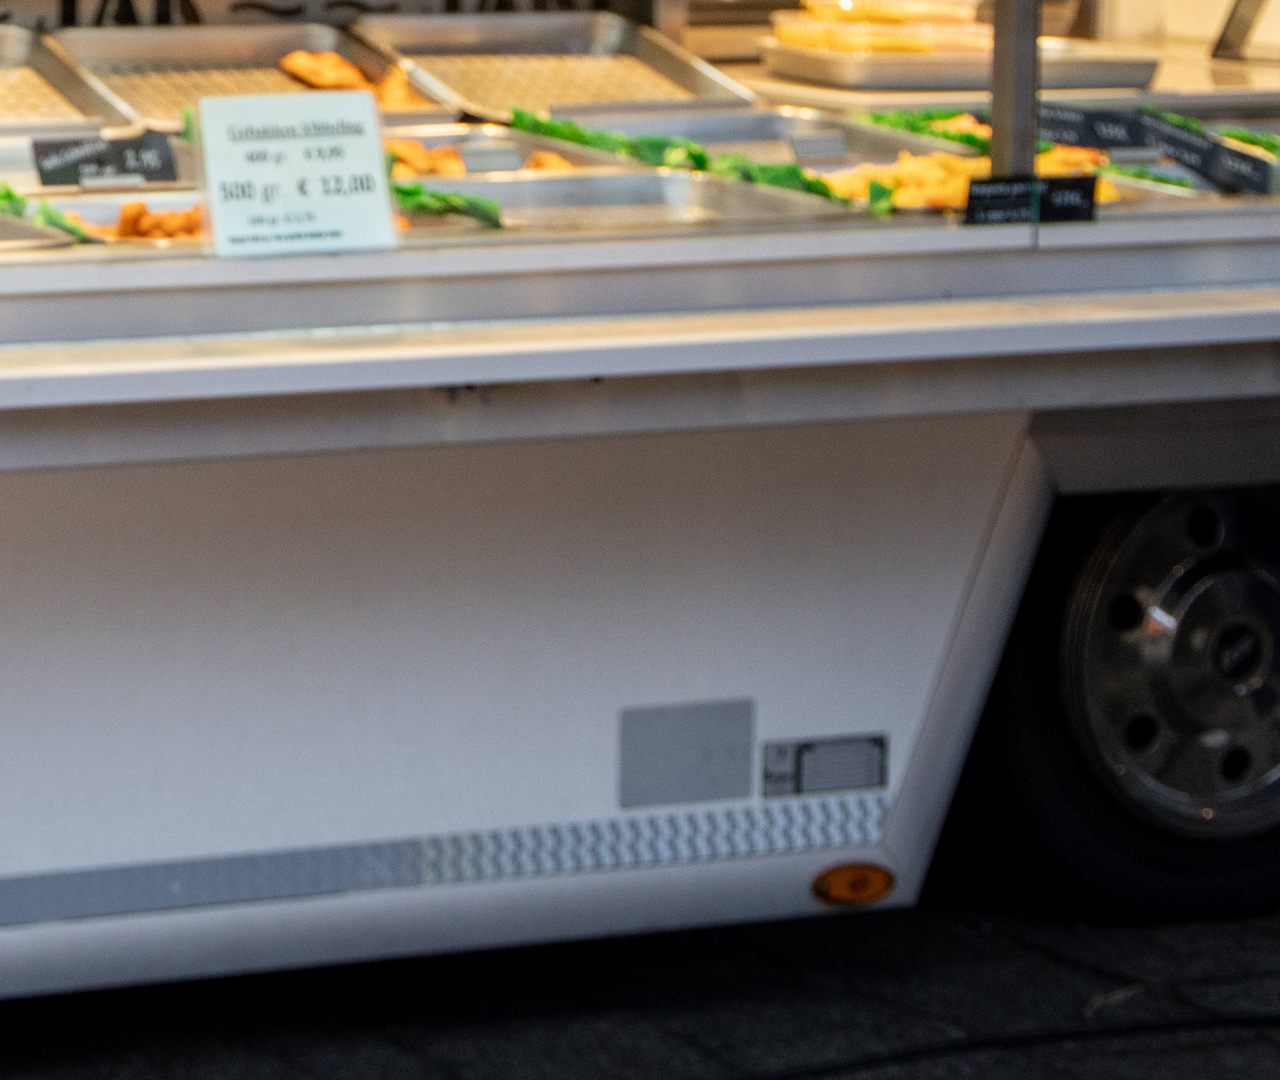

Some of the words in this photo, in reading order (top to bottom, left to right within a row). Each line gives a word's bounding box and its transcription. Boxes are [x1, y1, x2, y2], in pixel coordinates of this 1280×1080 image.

[219, 179, 256, 201] 500
[295, 176, 310, 197] €
[320, 173, 377, 196] 12,00
